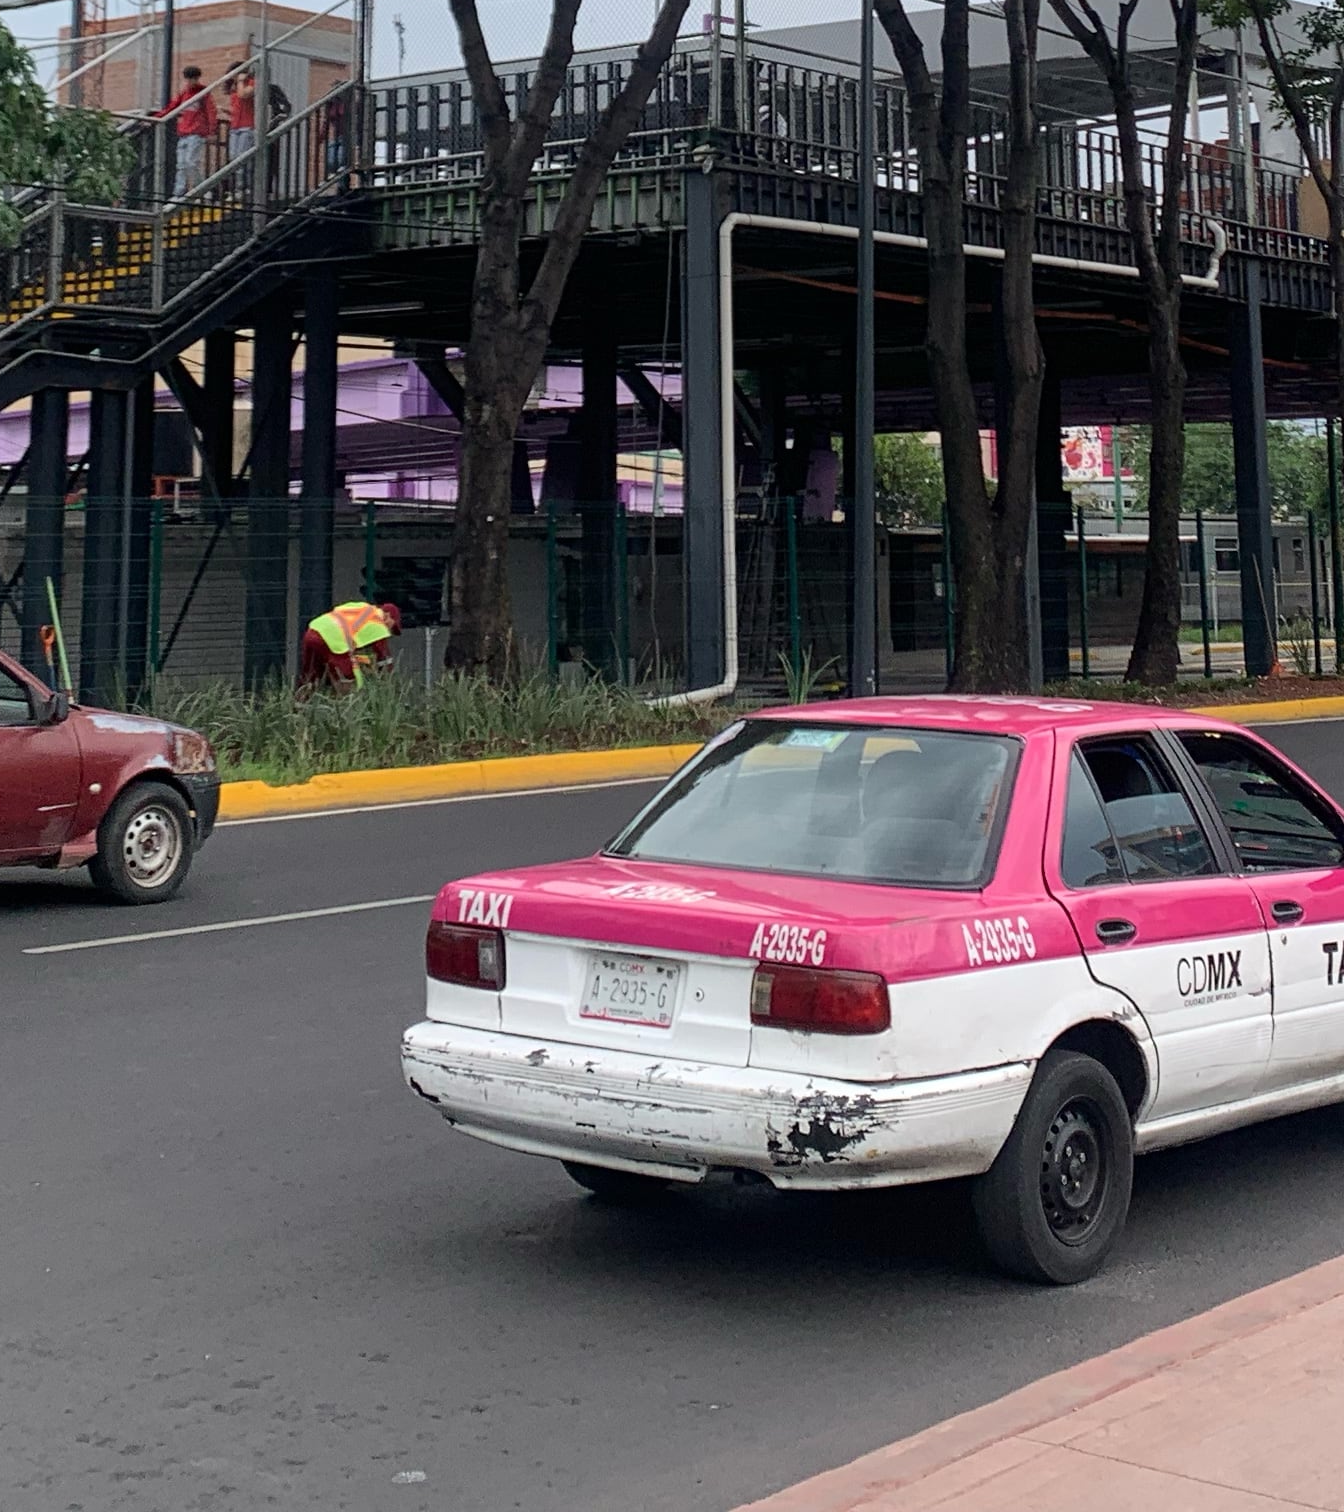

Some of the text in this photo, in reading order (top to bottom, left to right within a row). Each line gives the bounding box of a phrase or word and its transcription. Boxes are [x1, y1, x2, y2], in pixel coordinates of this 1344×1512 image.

[458, 890, 513, 927] TAXI
[749, 922, 827, 966] A-2935-G
[961, 915, 1036, 967] A-2935-G
[619, 963, 645, 974] CDMX
[1177, 950, 1243, 997] CDMX
[591, 974, 668, 1009] A-2935-G
[1184, 997, 1206, 1007] CIUDAD
[1207, 995, 1214, 1003] DE
